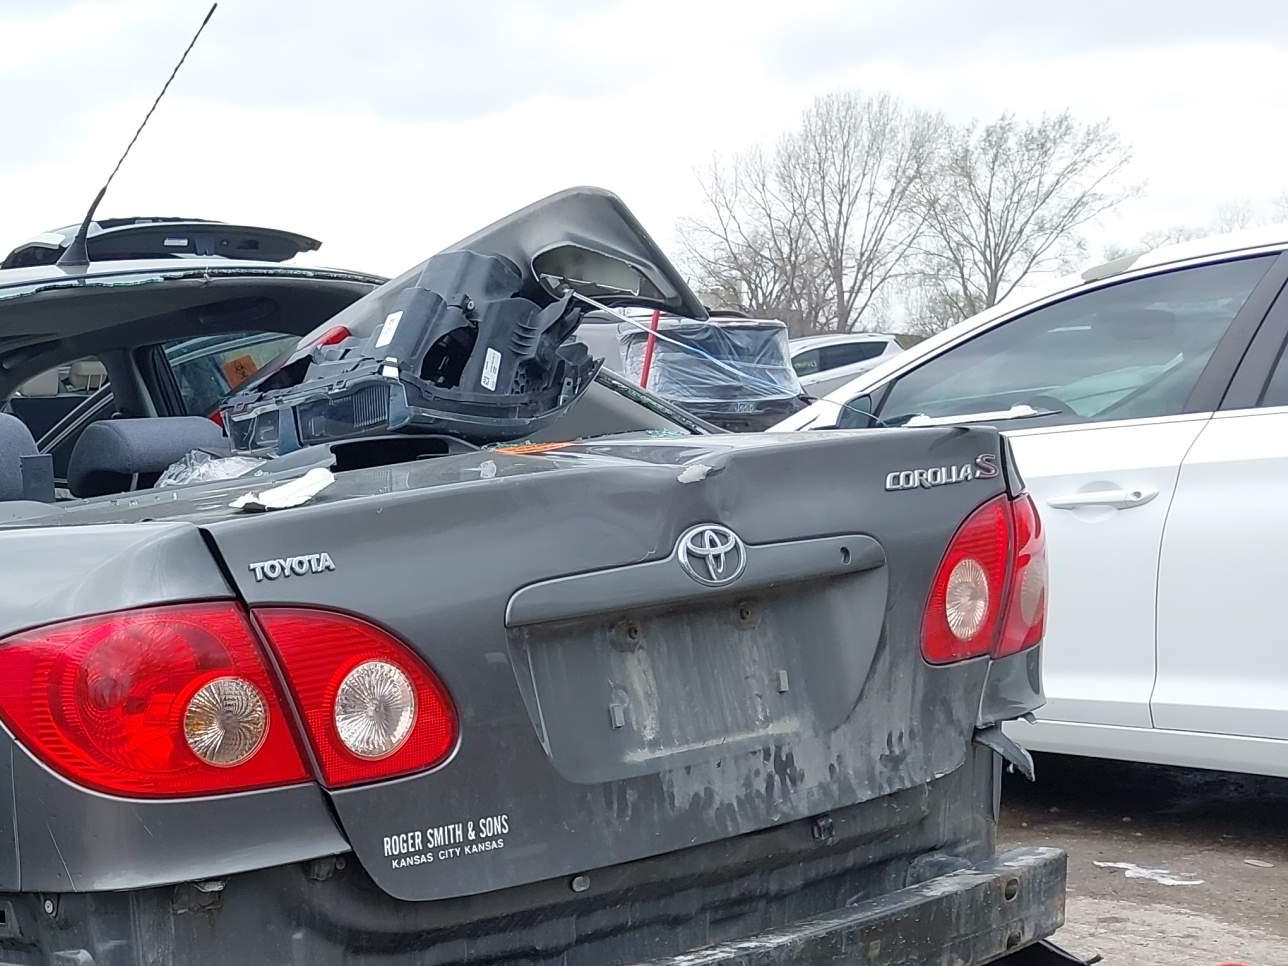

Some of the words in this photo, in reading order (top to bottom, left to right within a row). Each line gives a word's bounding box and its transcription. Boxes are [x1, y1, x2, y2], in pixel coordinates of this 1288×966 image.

[885, 463, 974, 491] COROLLA
[974, 453, 1000, 480] S
[248, 552, 336, 582] TOYOTA
[383, 831, 423, 857] ROGER
[426, 822, 463, 849] SMITH
[467, 821, 476, 841] &
[478, 814, 510, 838] SONS
[392, 853, 434, 869] KANSAS
[438, 847, 462, 860] CITY
[464, 838, 505, 855] KANSAS
